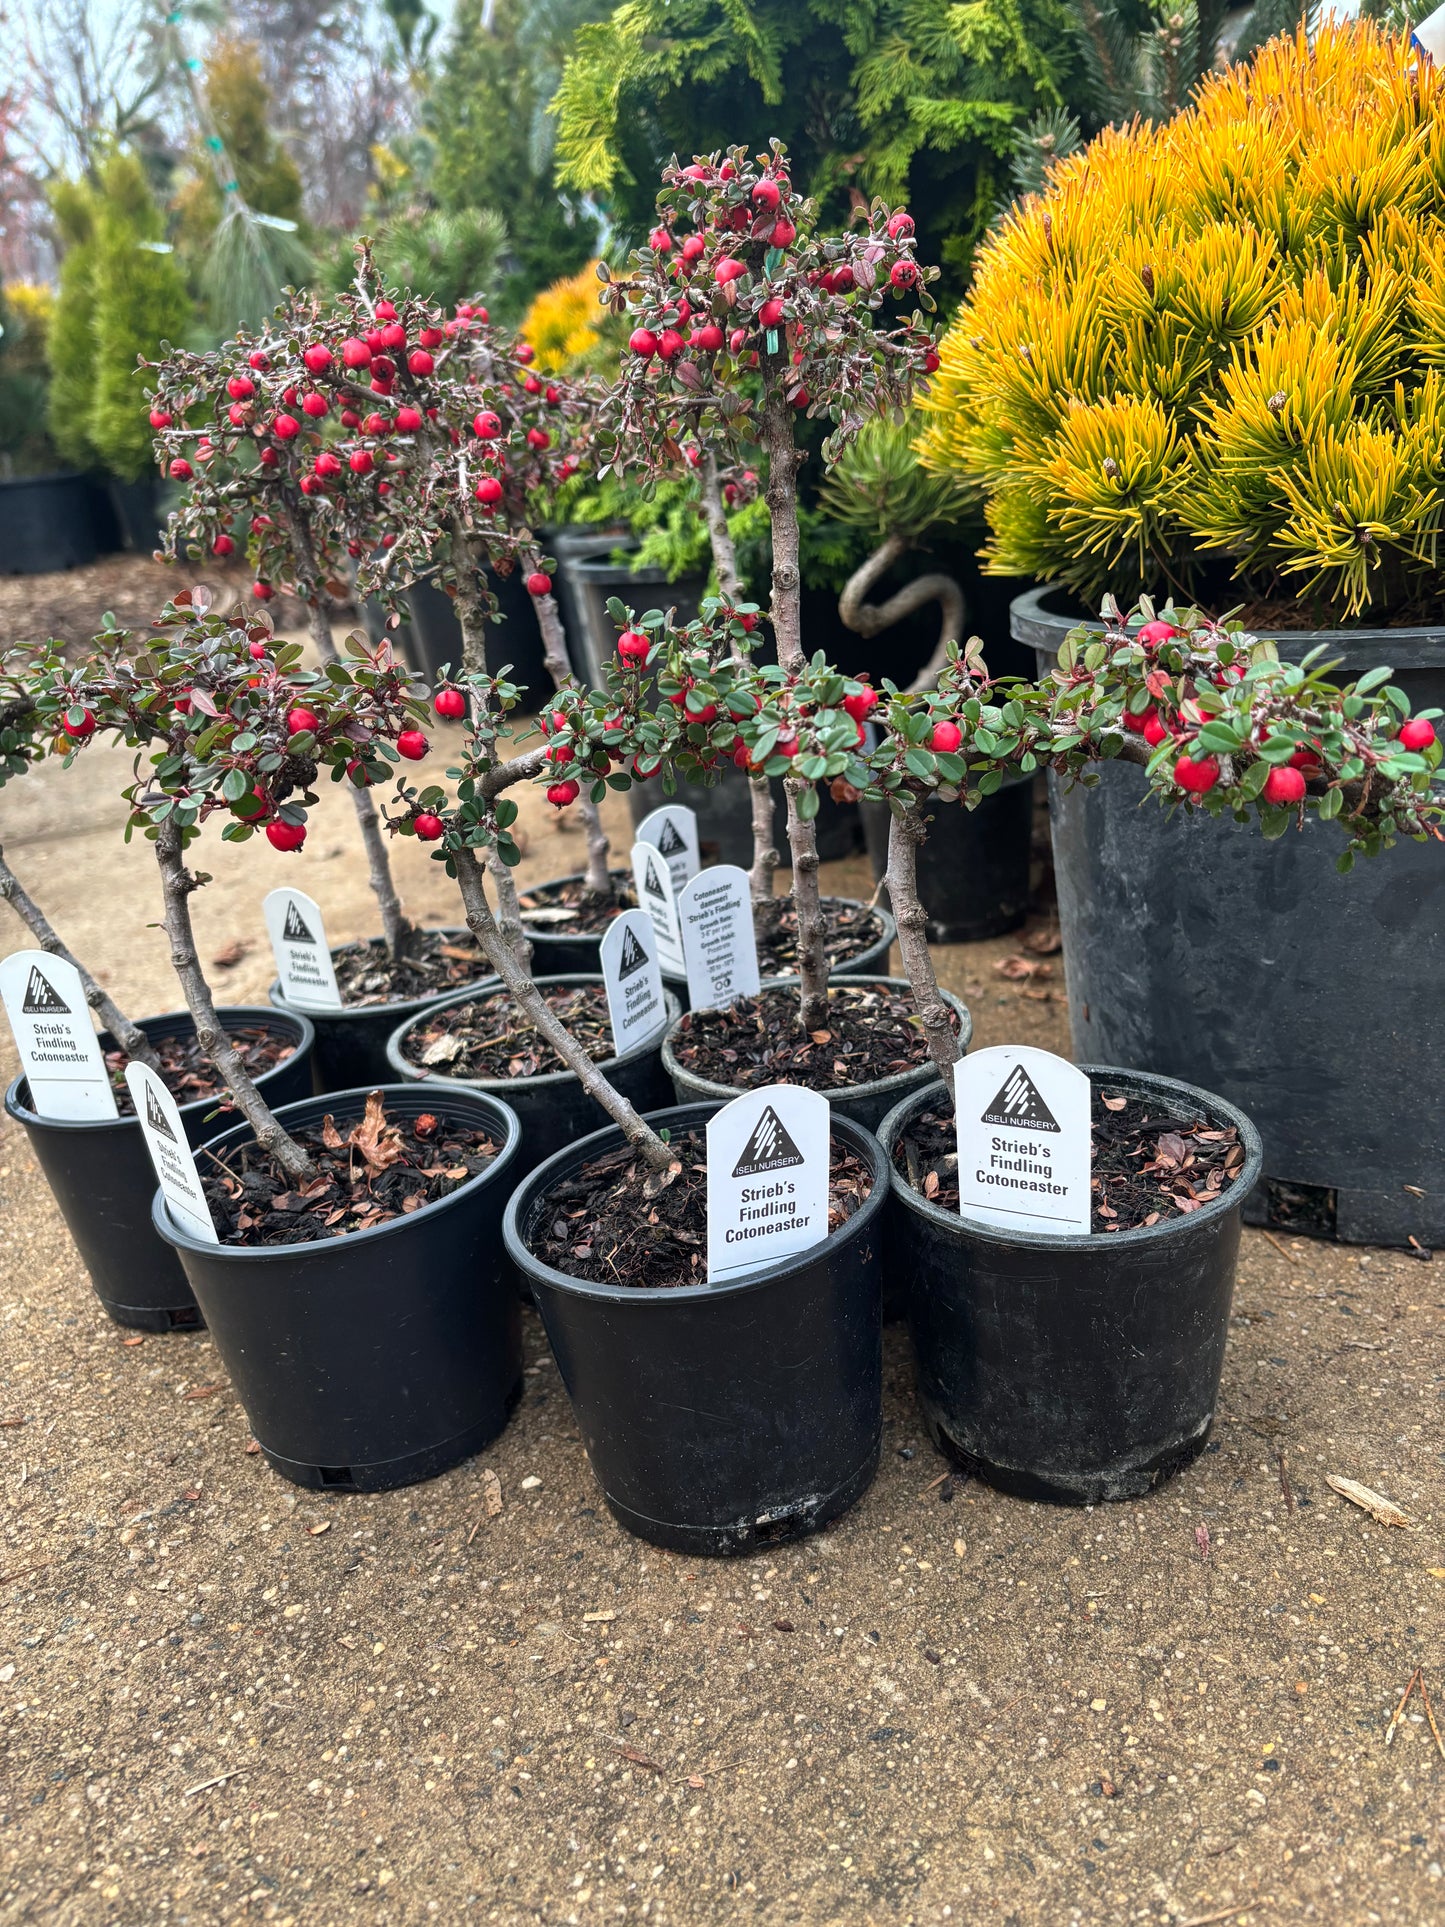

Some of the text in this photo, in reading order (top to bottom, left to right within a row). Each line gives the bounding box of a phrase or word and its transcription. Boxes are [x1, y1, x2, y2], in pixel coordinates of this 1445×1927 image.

[693, 883, 732, 901] Cotoneaster
[700, 892, 728, 909] dammeri
[625, 976, 649, 999] Strieb's
[626, 989, 651, 1013] Findling
[622, 998, 658, 1030] Cotoneaster
[33, 1023, 71, 1035] Strieb's
[36, 1037, 76, 1051] Findling
[31, 1051, 88, 1063] Cotoneaster
[985, 1114, 1056, 1131] ISELI NURSERY
[991, 1137, 1051, 1158] Strieb's
[736, 1155, 800, 1175] ISELI NURSERY
[990, 1154, 1052, 1179] Findling
[741, 1180, 795, 1203] Strieb's
[976, 1170, 1069, 1196] Cotoneaster
[739, 1200, 796, 1222] Findling
[725, 1216, 810, 1243] Cotoneaster
